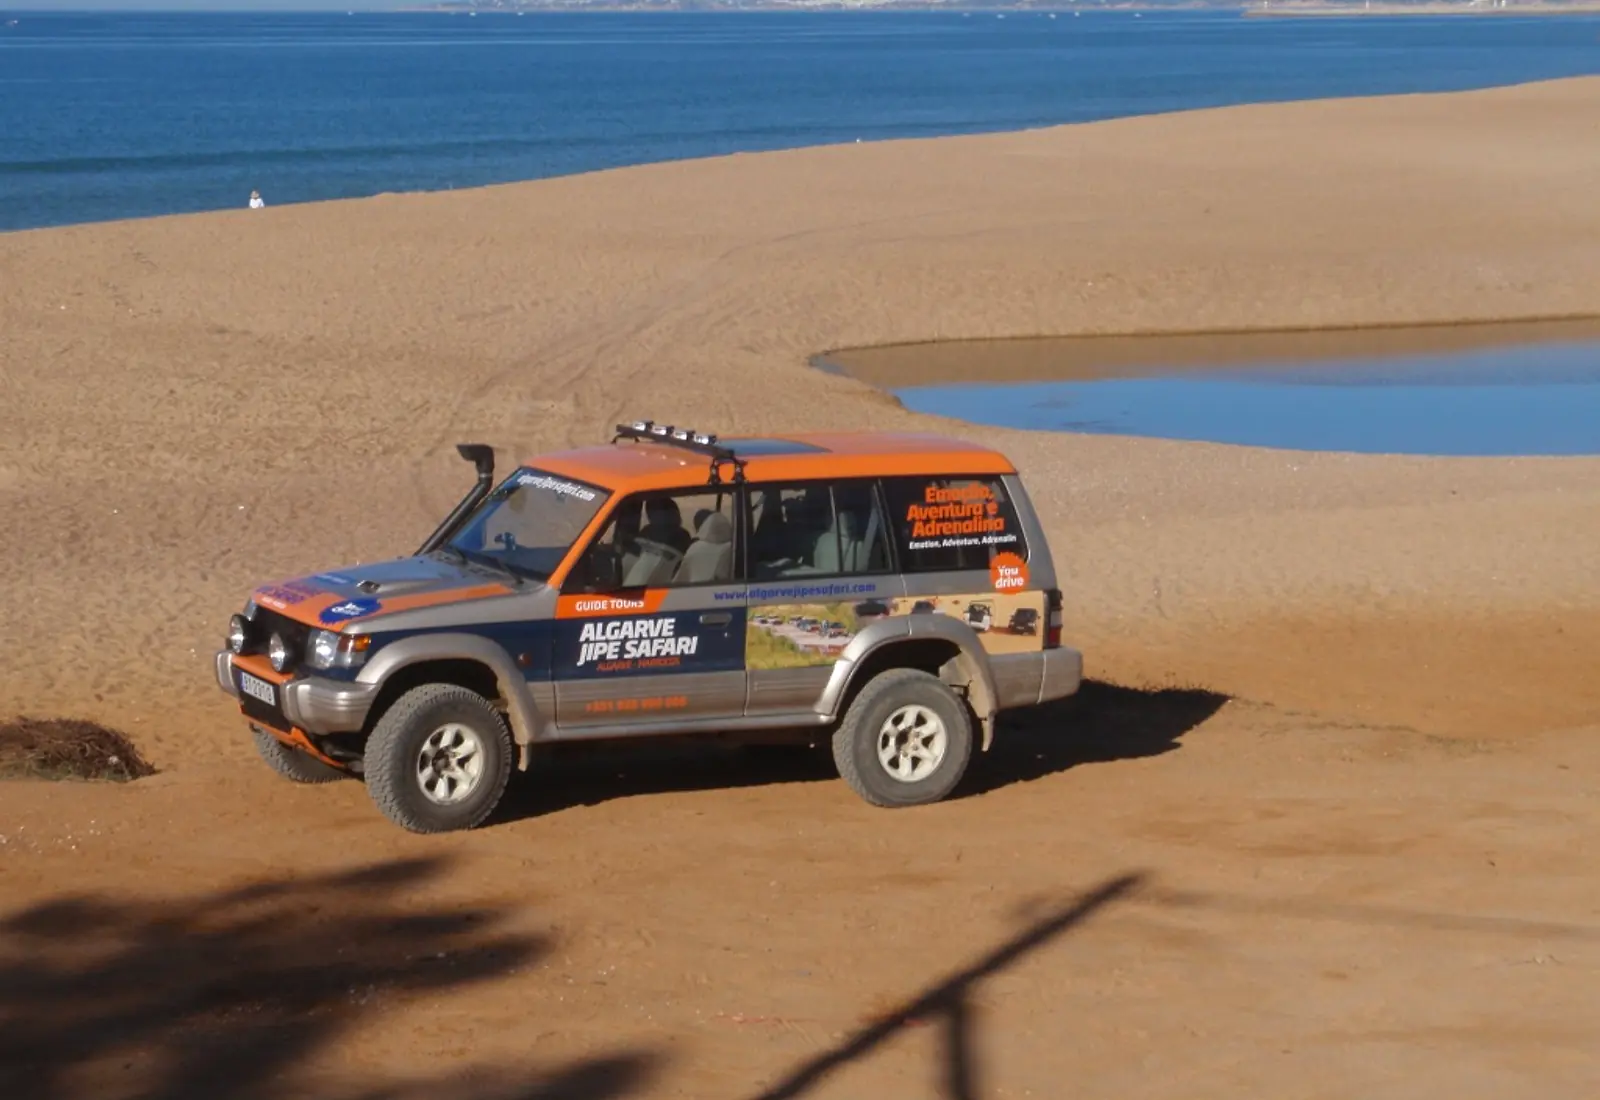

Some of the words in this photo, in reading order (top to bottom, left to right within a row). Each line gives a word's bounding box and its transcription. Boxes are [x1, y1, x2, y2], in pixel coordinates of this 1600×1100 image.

[907, 502, 983, 521] Aventura
[985, 501, 998, 515] e
[912, 516, 1004, 538] Adrenalina
[909, 540, 941, 549] Emotion,
[942, 537, 980, 547] Adventure,
[998, 565, 1019, 576] You
[995, 576, 1024, 588] drive
[714, 583, 876, 601] www.algarvejipesafari.com
[575, 600, 608, 611] GUIDE
[610, 599, 644, 609] TOURS
[579, 618, 676, 642] ALGARVE
[577, 641, 621, 666] JIPE
[623, 636, 698, 659] SAFARI
